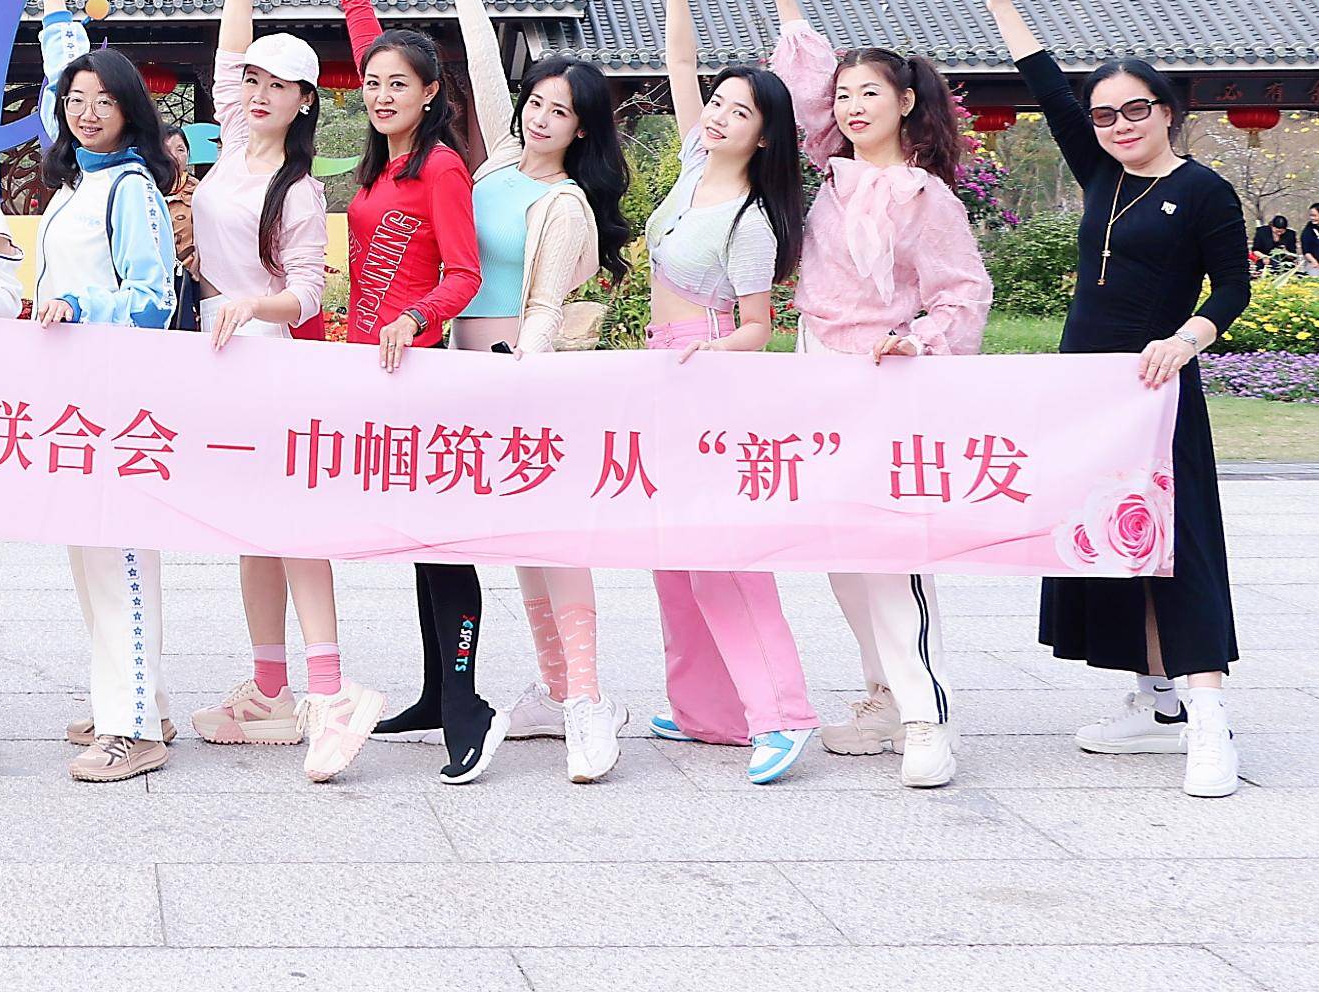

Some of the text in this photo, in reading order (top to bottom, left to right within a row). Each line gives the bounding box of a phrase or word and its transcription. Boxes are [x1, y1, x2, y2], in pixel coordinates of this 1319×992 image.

[355, 209, 422, 335] RUNNING
[285, 419, 565, 496] 巾帼筑梦
[592, 431, 659, 499] 从
[890, 434, 1032, 504] 出发
